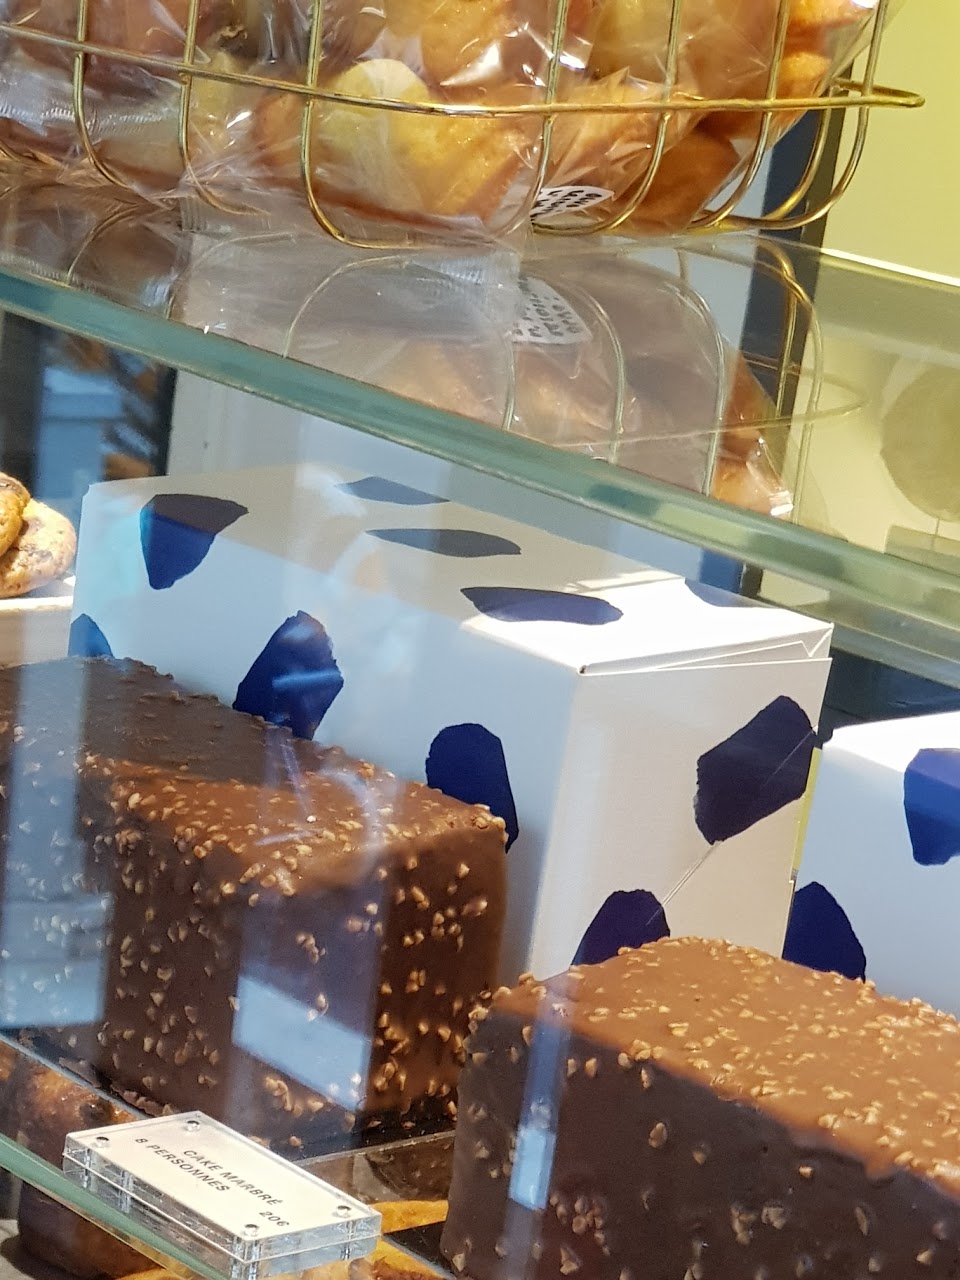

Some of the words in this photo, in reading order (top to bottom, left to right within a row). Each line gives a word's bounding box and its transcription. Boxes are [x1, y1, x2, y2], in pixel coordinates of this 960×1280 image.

[146, 1144, 230, 1192] PERSONNES
[183, 1149, 223, 1172] CAKE
[219, 1171, 284, 1206] MARBRÉ
